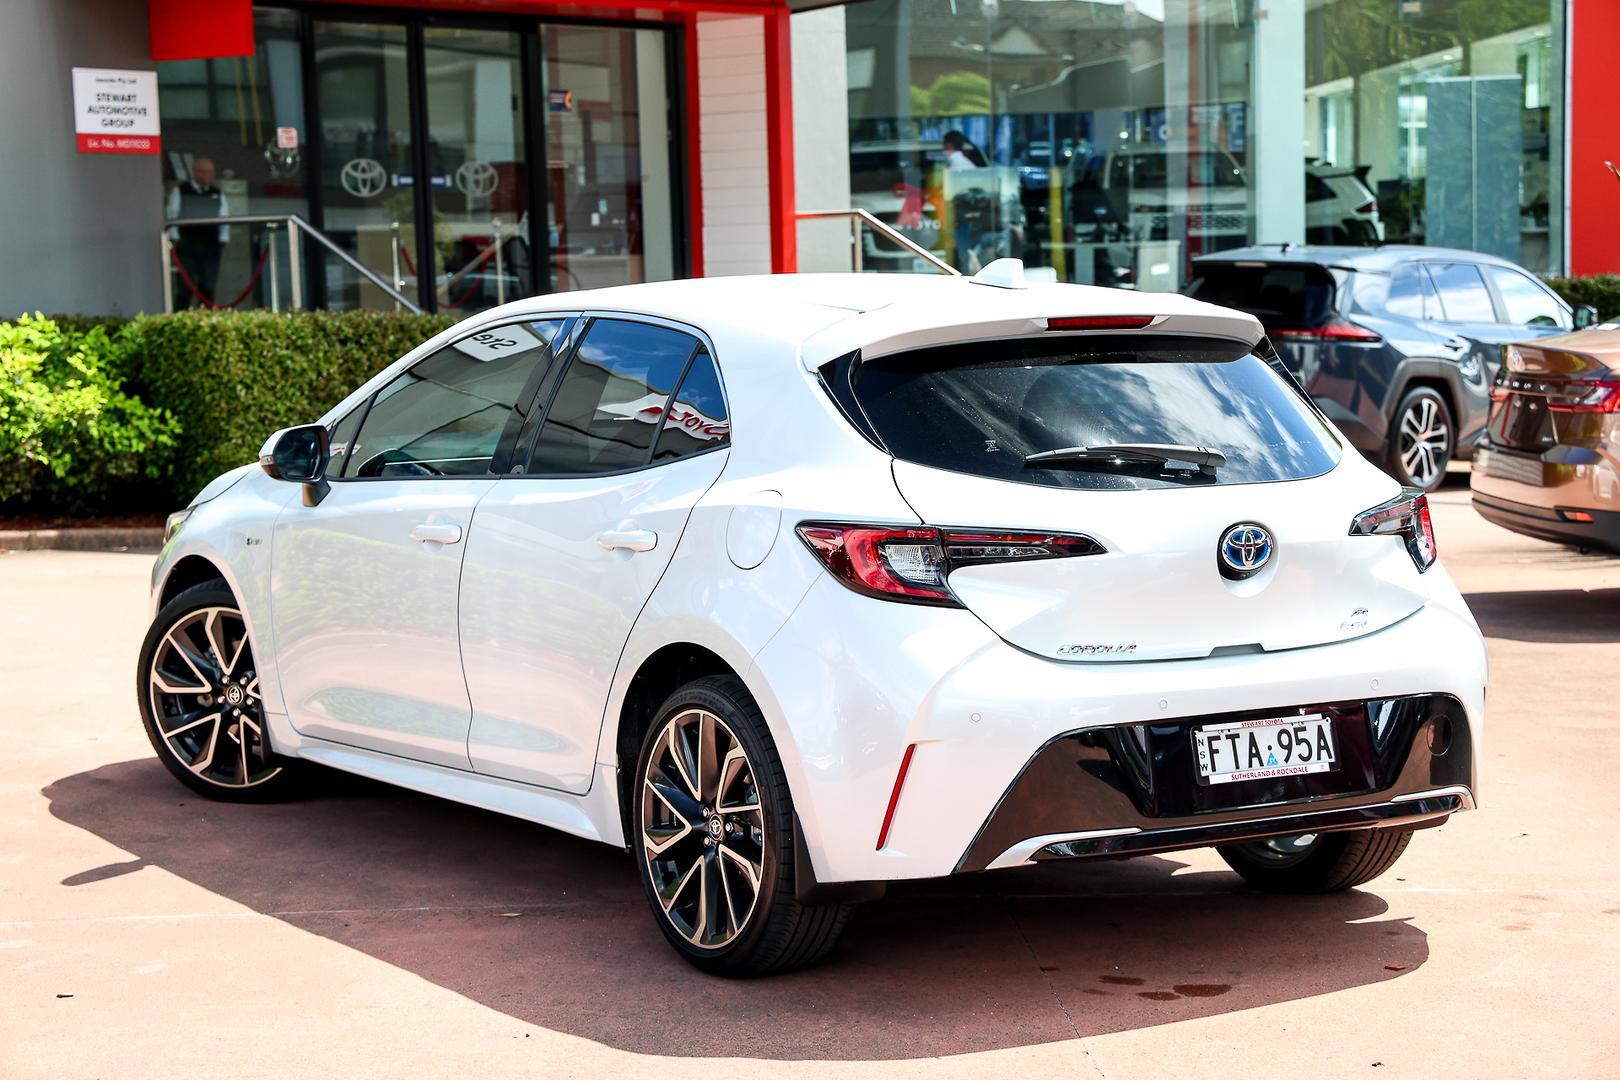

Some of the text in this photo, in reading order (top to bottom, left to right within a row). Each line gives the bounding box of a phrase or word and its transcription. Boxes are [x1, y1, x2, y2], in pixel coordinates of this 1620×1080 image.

[96, 92, 137, 102] STEWART
[87, 105, 148, 116] AUTOMOTIVE
[101, 119, 135, 128] GROUP
[1056, 644, 1138, 655] COROLLA
[1241, 718, 1284, 728] STEWART TOYOTA
[1231, 769, 1271, 781] SUTHERLAND
[1276, 766, 1309, 776] ROCKDALE
